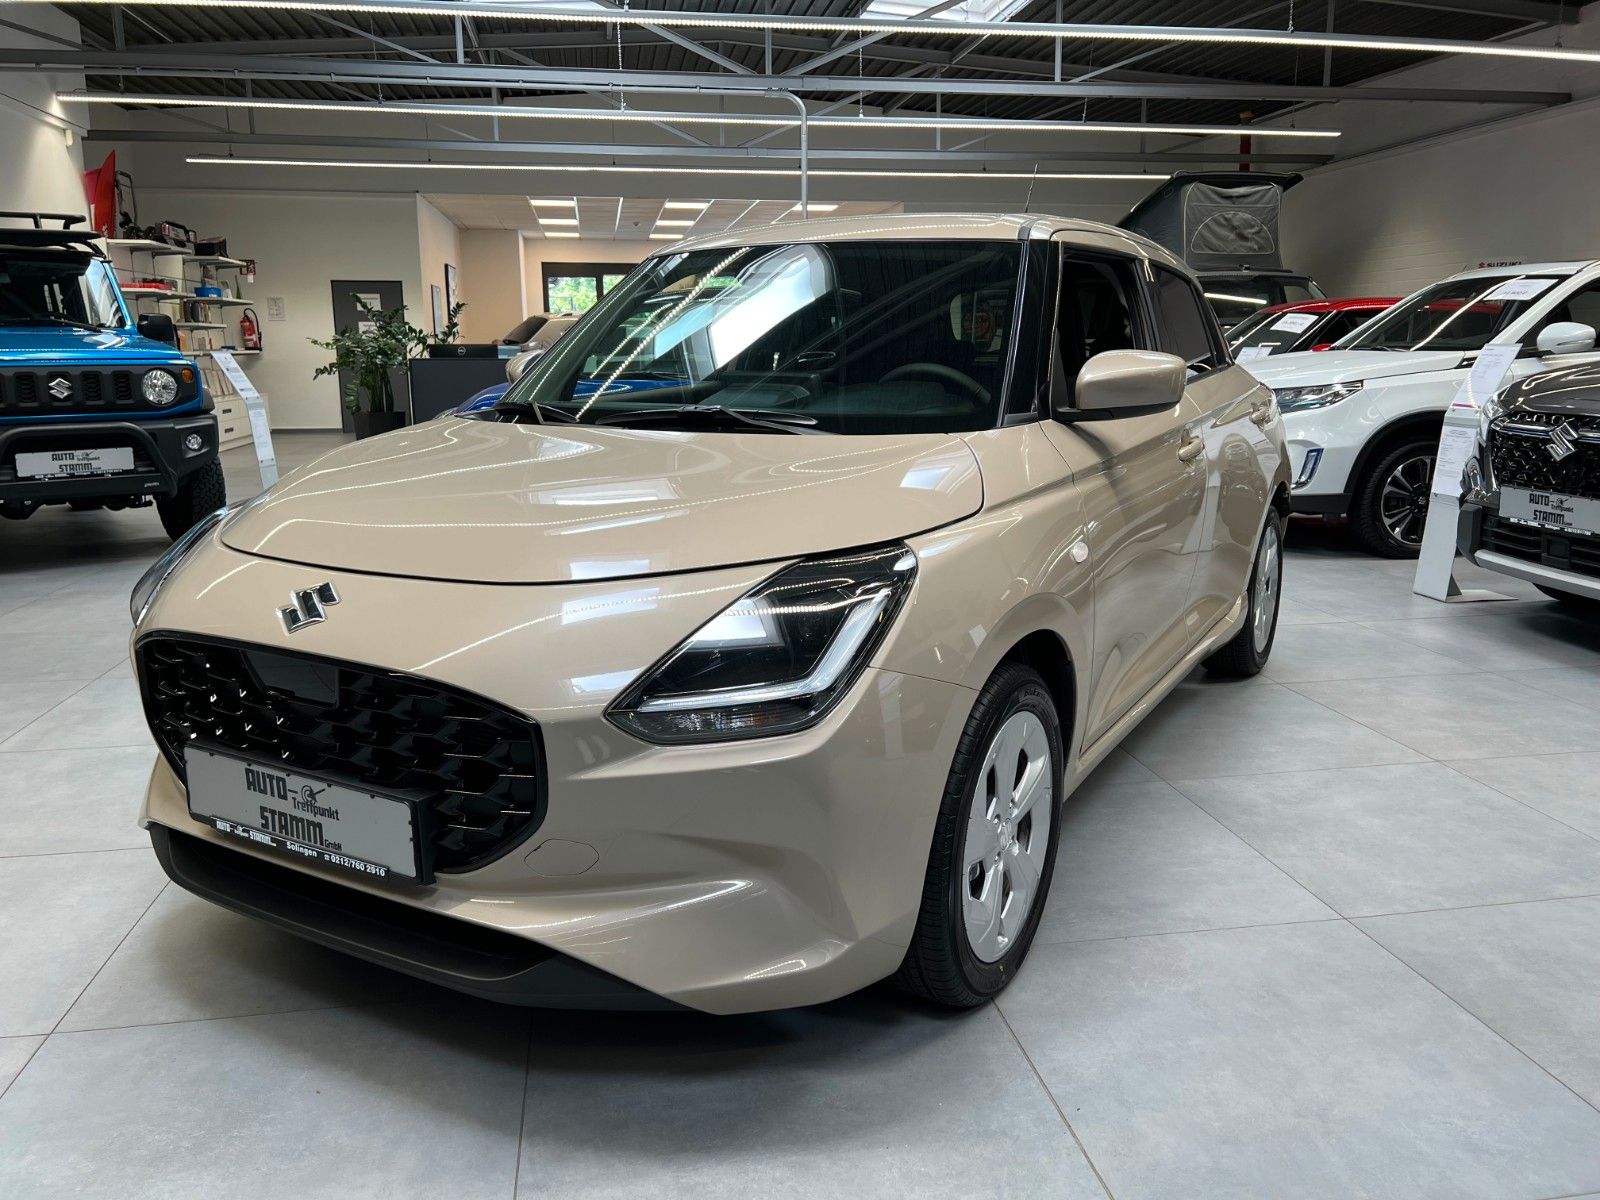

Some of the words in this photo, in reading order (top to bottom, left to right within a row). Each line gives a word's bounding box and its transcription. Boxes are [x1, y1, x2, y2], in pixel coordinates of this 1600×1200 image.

[59, 463, 92, 473] STAMM
[1533, 509, 1564, 525] STAMM
[292, 797, 340, 821] Treffpunkt
[259, 805, 324, 847] STAMM
[286, 841, 318, 857] Solingen
